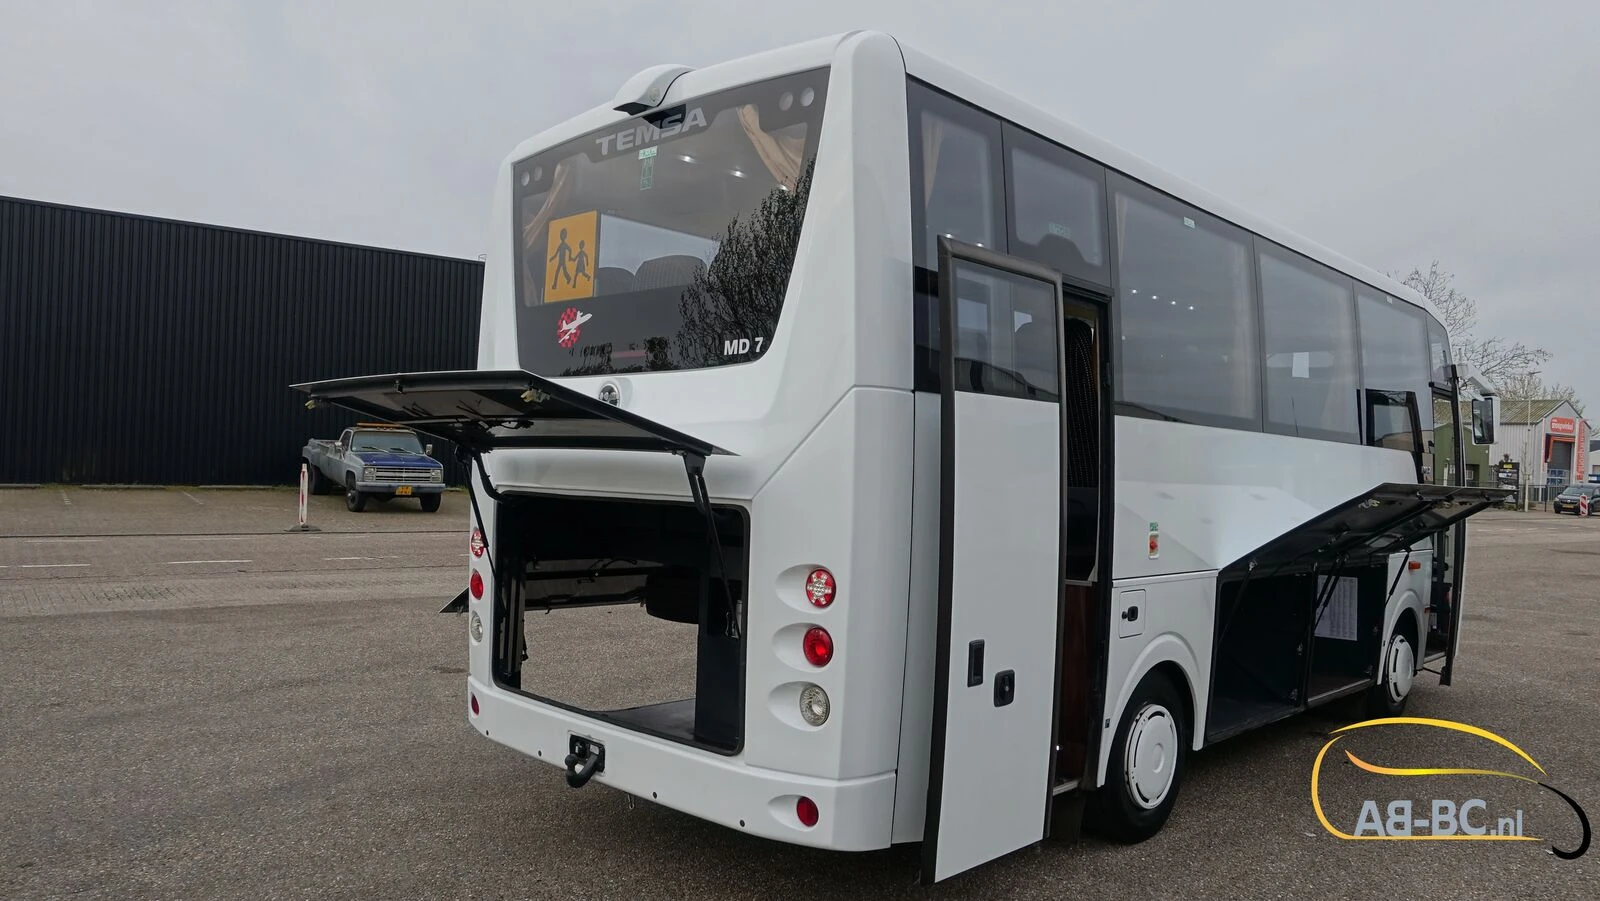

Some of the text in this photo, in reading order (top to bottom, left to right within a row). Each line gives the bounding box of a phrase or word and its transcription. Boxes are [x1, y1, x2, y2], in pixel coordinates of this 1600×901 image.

[596, 107, 707, 156] TEMSA
[723, 336, 764, 356] MD 7
